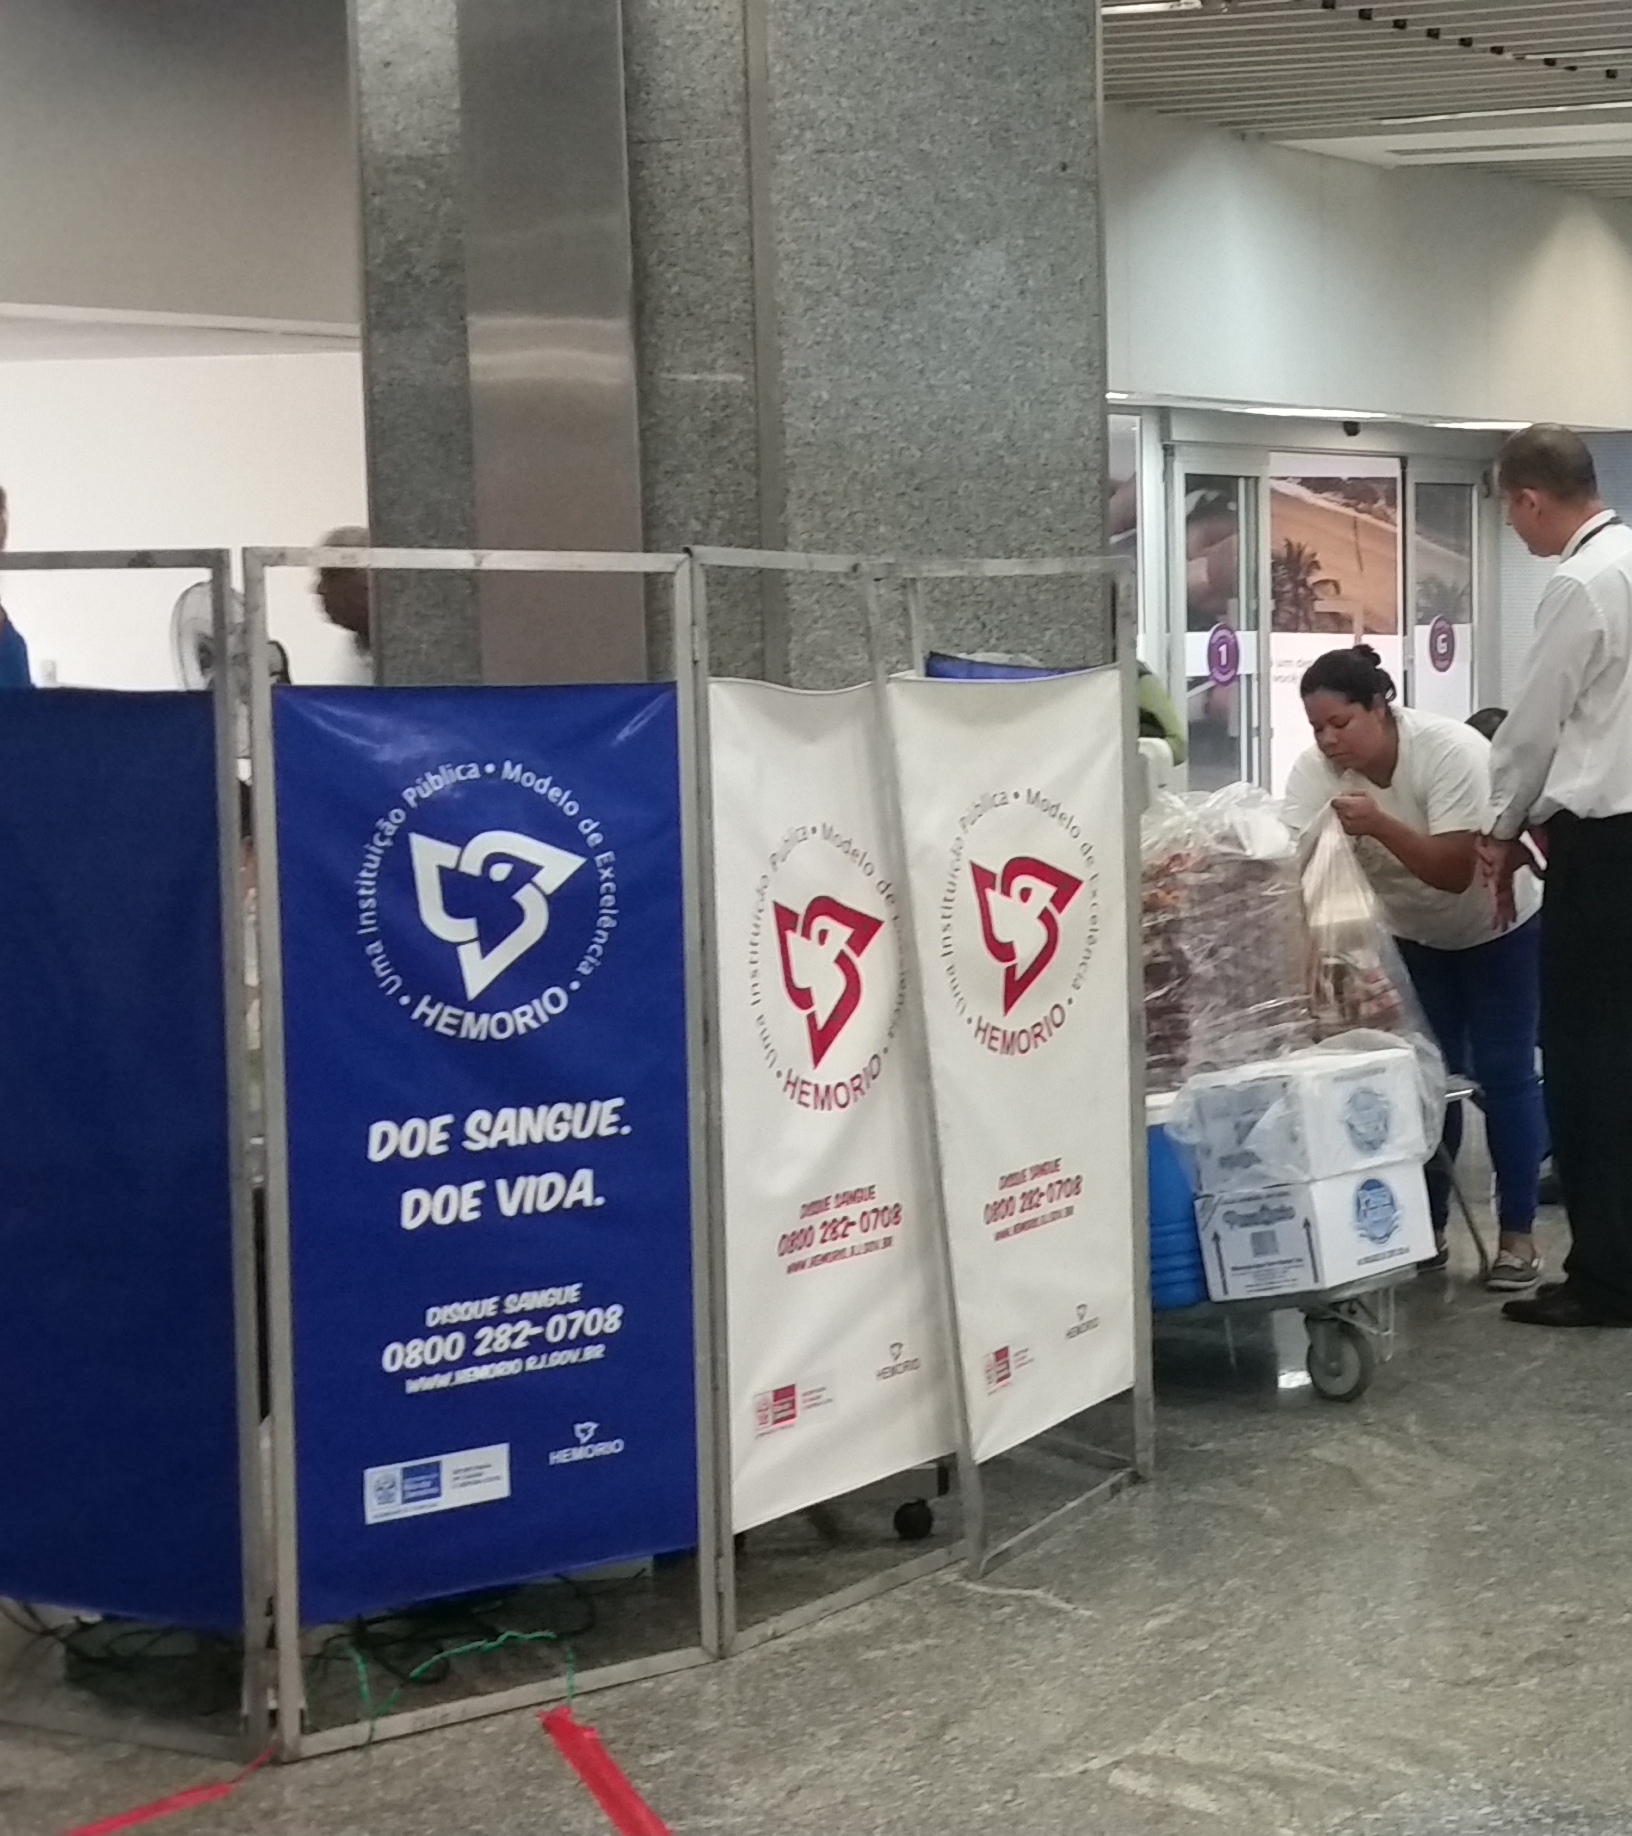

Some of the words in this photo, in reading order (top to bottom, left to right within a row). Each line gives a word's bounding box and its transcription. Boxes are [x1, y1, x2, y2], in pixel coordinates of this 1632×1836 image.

[1218, 643, 1228, 667] 1
[401, 762, 481, 808] Pública
[501, 759, 580, 817] Modelo
[577, 817, 604, 848] de
[354, 808, 406, 935] Instituição
[576, 850, 620, 975] Excelência
[365, 938, 403, 996] Uma
[411, 985, 569, 1041] HEMORIO
[974, 1003, 1067, 1056] HEMORIO
[782, 1053, 883, 1113] HEMORIO
[367, 1114, 455, 1163] DOE
[462, 1097, 632, 1152] SANGUE.
[401, 1180, 486, 1231] DOE
[495, 1167, 606, 1217] VIDA.
[425, 1296, 501, 1328] DISQUE
[501, 1282, 584, 1315] SANGUE
[381, 1331, 467, 1373] 0800
[472, 1303, 625, 1358] 282-0708
[548, 1438, 625, 1466] HEMORIO
